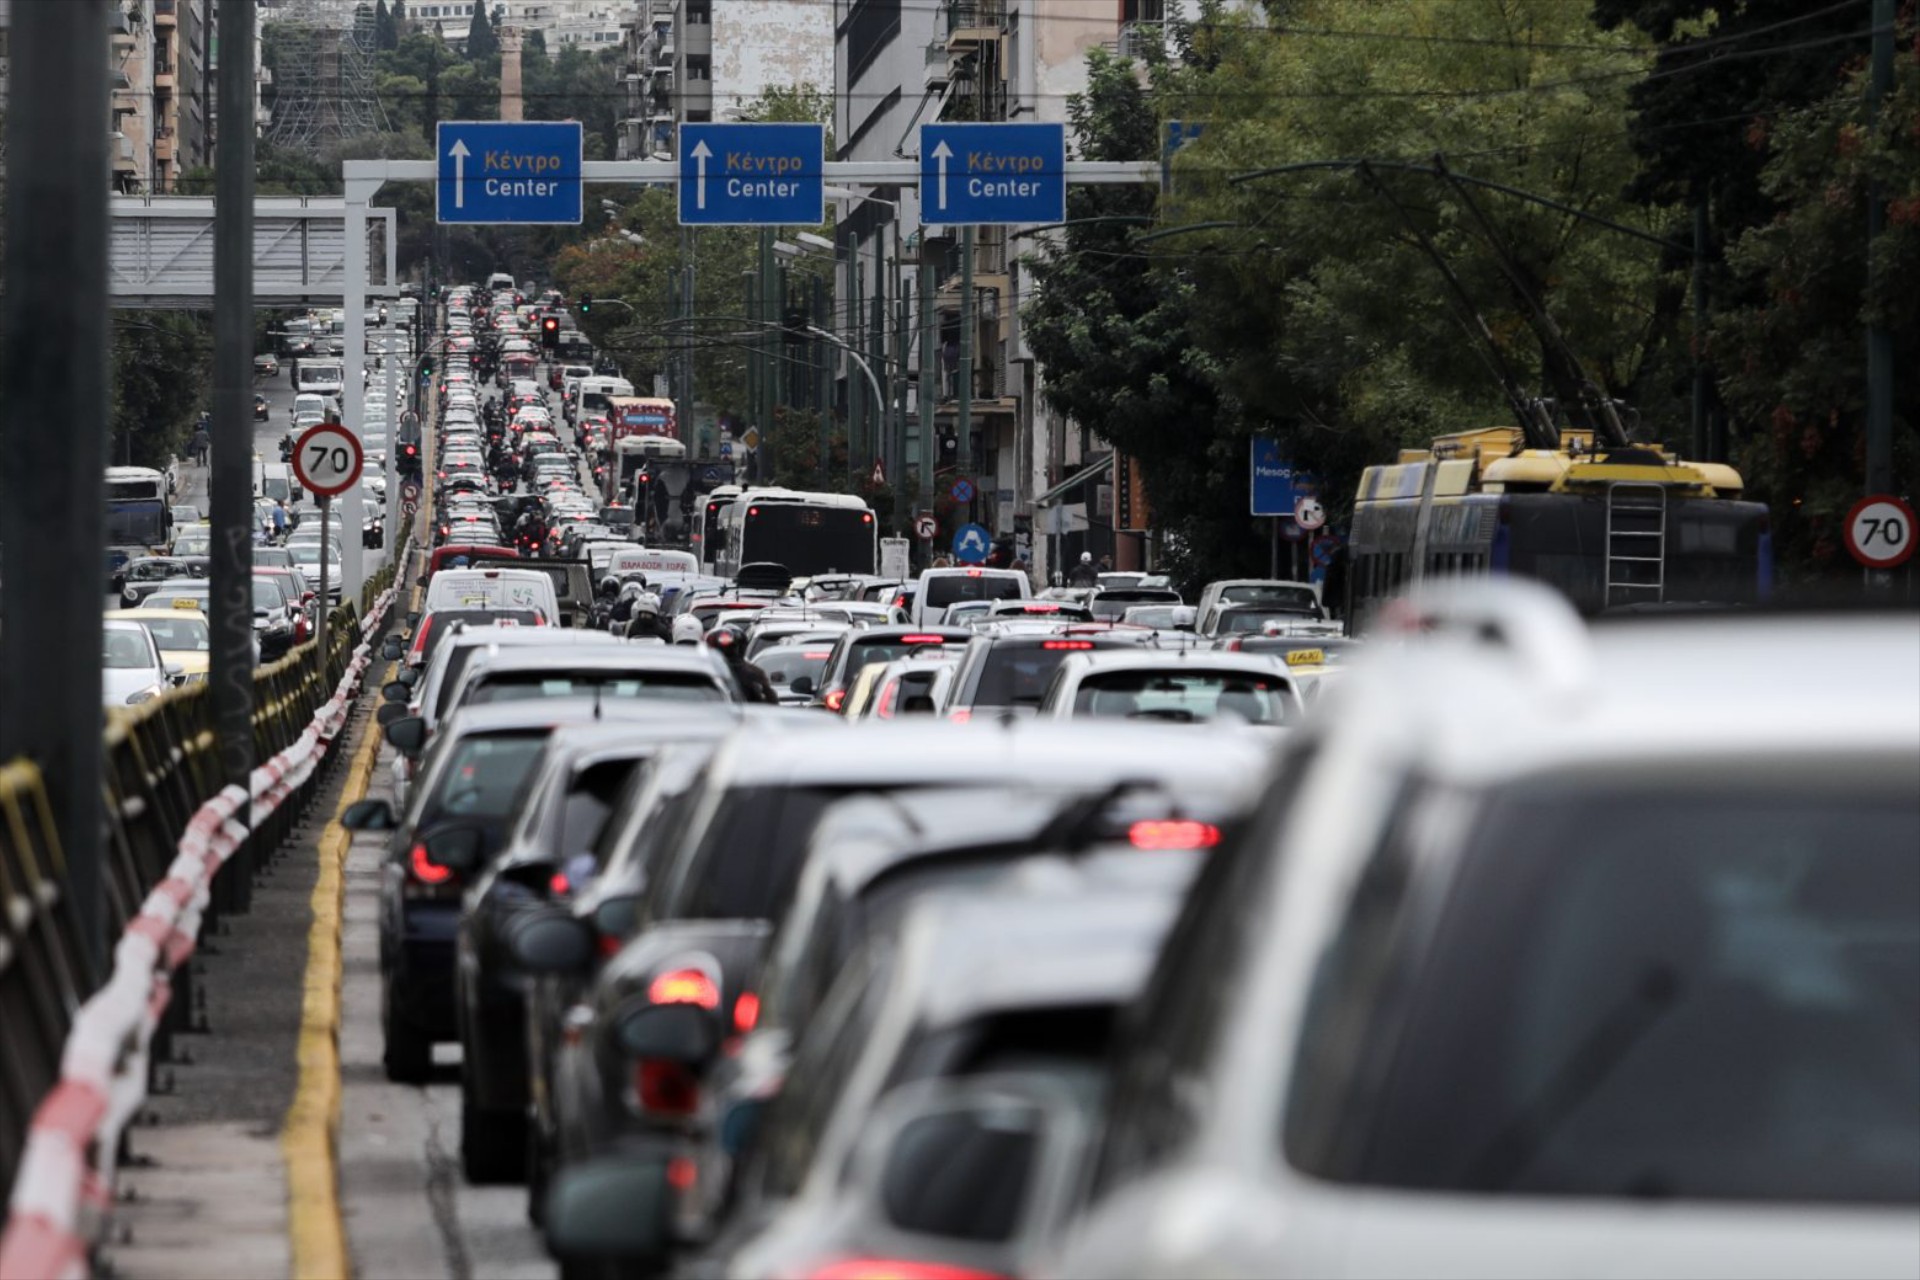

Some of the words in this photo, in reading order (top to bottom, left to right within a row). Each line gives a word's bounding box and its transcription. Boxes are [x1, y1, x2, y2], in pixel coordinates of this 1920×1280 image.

[485, 150, 561, 174] Κέντρο
[727, 151, 803, 176] Κέντρο
[968, 151, 1044, 174] Κέντρο
[485, 178, 559, 197] Center
[727, 178, 800, 197] Center
[968, 178, 1042, 197] Center
[309, 446, 348, 474] 70
[1256, 466, 1291, 479] Mesog
[1862, 518, 1903, 546] 70
